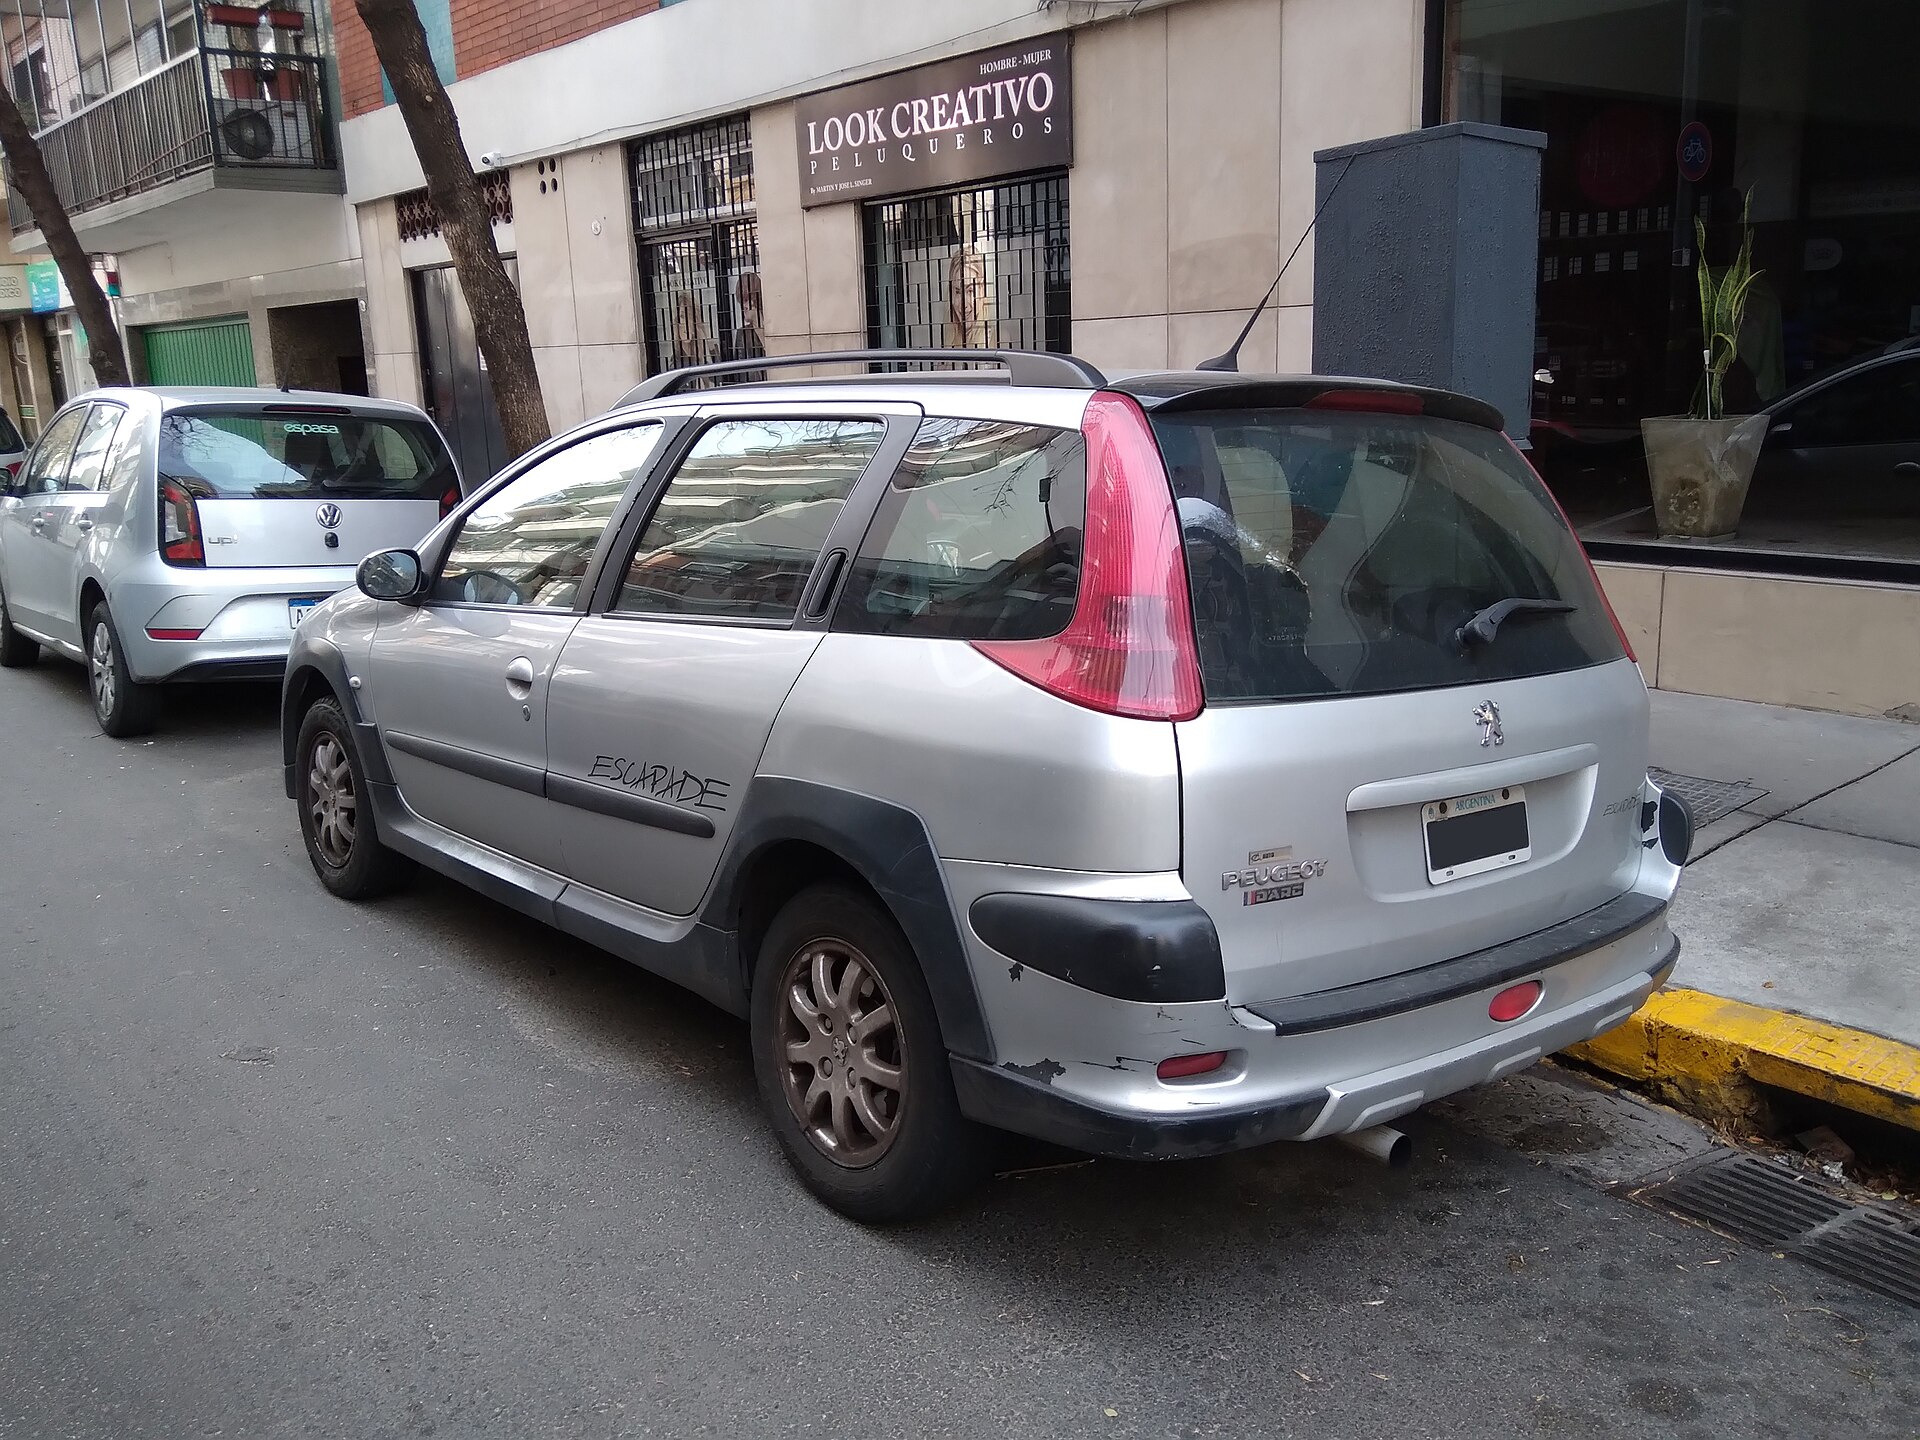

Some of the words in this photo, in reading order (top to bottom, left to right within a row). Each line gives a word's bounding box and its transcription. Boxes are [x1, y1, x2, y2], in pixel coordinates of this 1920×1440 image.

[980, 56, 1017, 75] HOMBRE
[1023, 49, 1052, 65] MUJER
[807, 107, 887, 155] LOOK
[891, 72, 1054, 139] CREATIVO
[810, 116, 1053, 175] PELUQUEROS
[816, 184, 835, 193] MARTIN
[855, 178, 873, 188] SINGER
[283, 423, 340, 436] espasa
[588, 755, 731, 812] ESCAPADE
[1455, 794, 1496, 812] ARGENTINA
[1221, 859, 1328, 892] PEUGEOT
